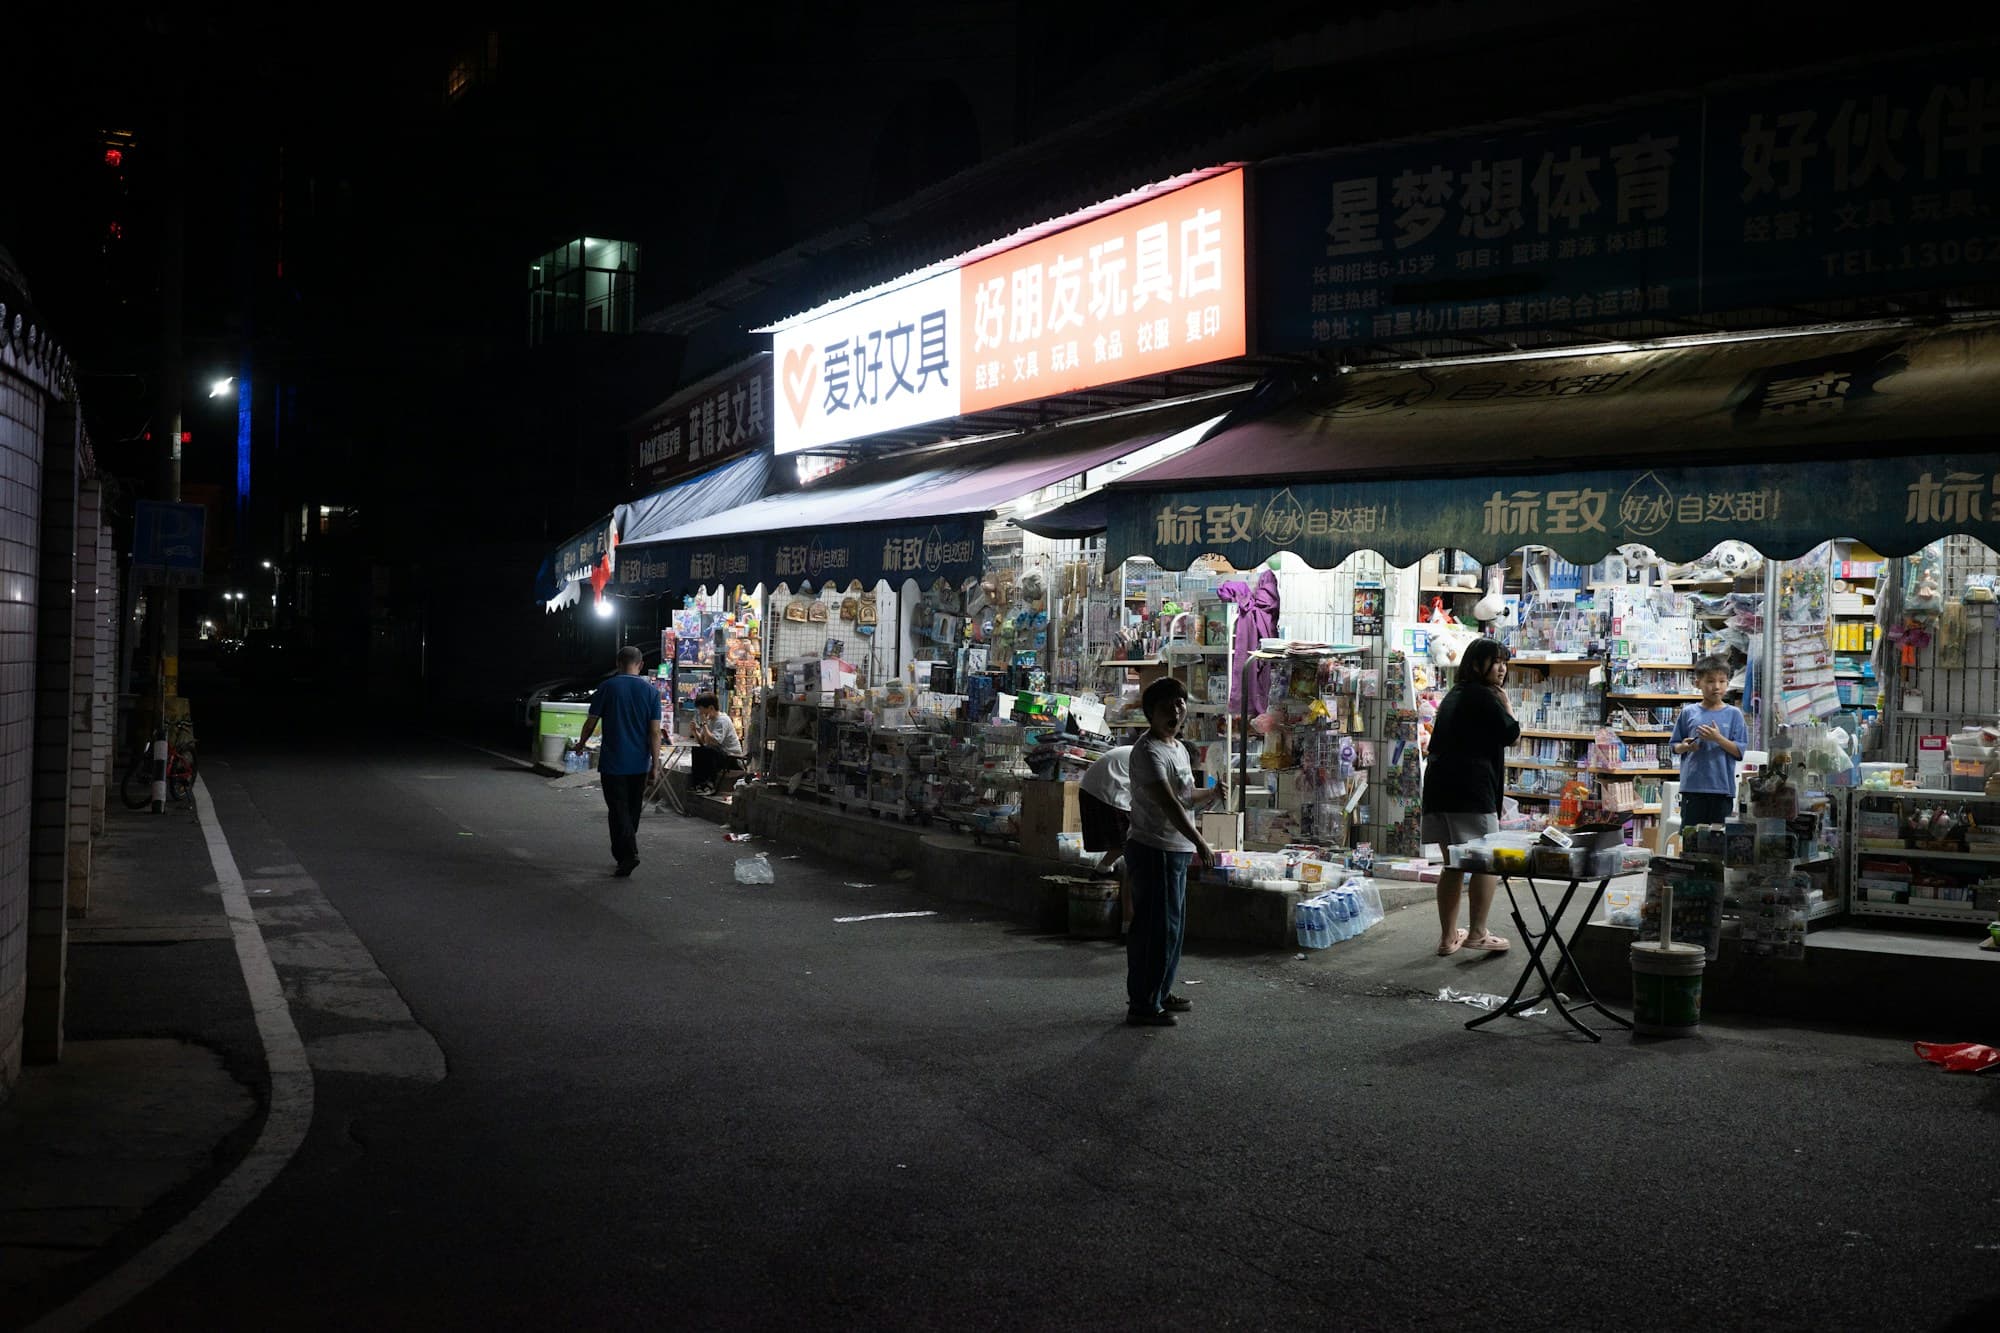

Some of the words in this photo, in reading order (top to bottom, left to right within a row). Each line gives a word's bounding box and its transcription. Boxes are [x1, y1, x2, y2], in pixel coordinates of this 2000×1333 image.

[1326, 135, 1680, 256] 星梦想体育
[974, 208, 1223, 353] 好朋友玩具店
[823, 308, 949, 416] 爱好文具
[1013, 351, 1039, 383] 文具
[1051, 341, 1080, 373] 玩具
[1093, 330, 1123, 363] 食品
[1137, 318, 1169, 353] 校服
[1185, 305, 1221, 342] 复印
[688, 375, 764, 463] 蓝精灵文具
[1155, 502, 1253, 546] 标致
[1262, 508, 1304, 536] 好水
[1482, 488, 1608, 535] 标致
[1622, 496, 1672, 525] 好水
[1904, 471, 2000, 525] 标
[882, 535, 922, 571] 标致
